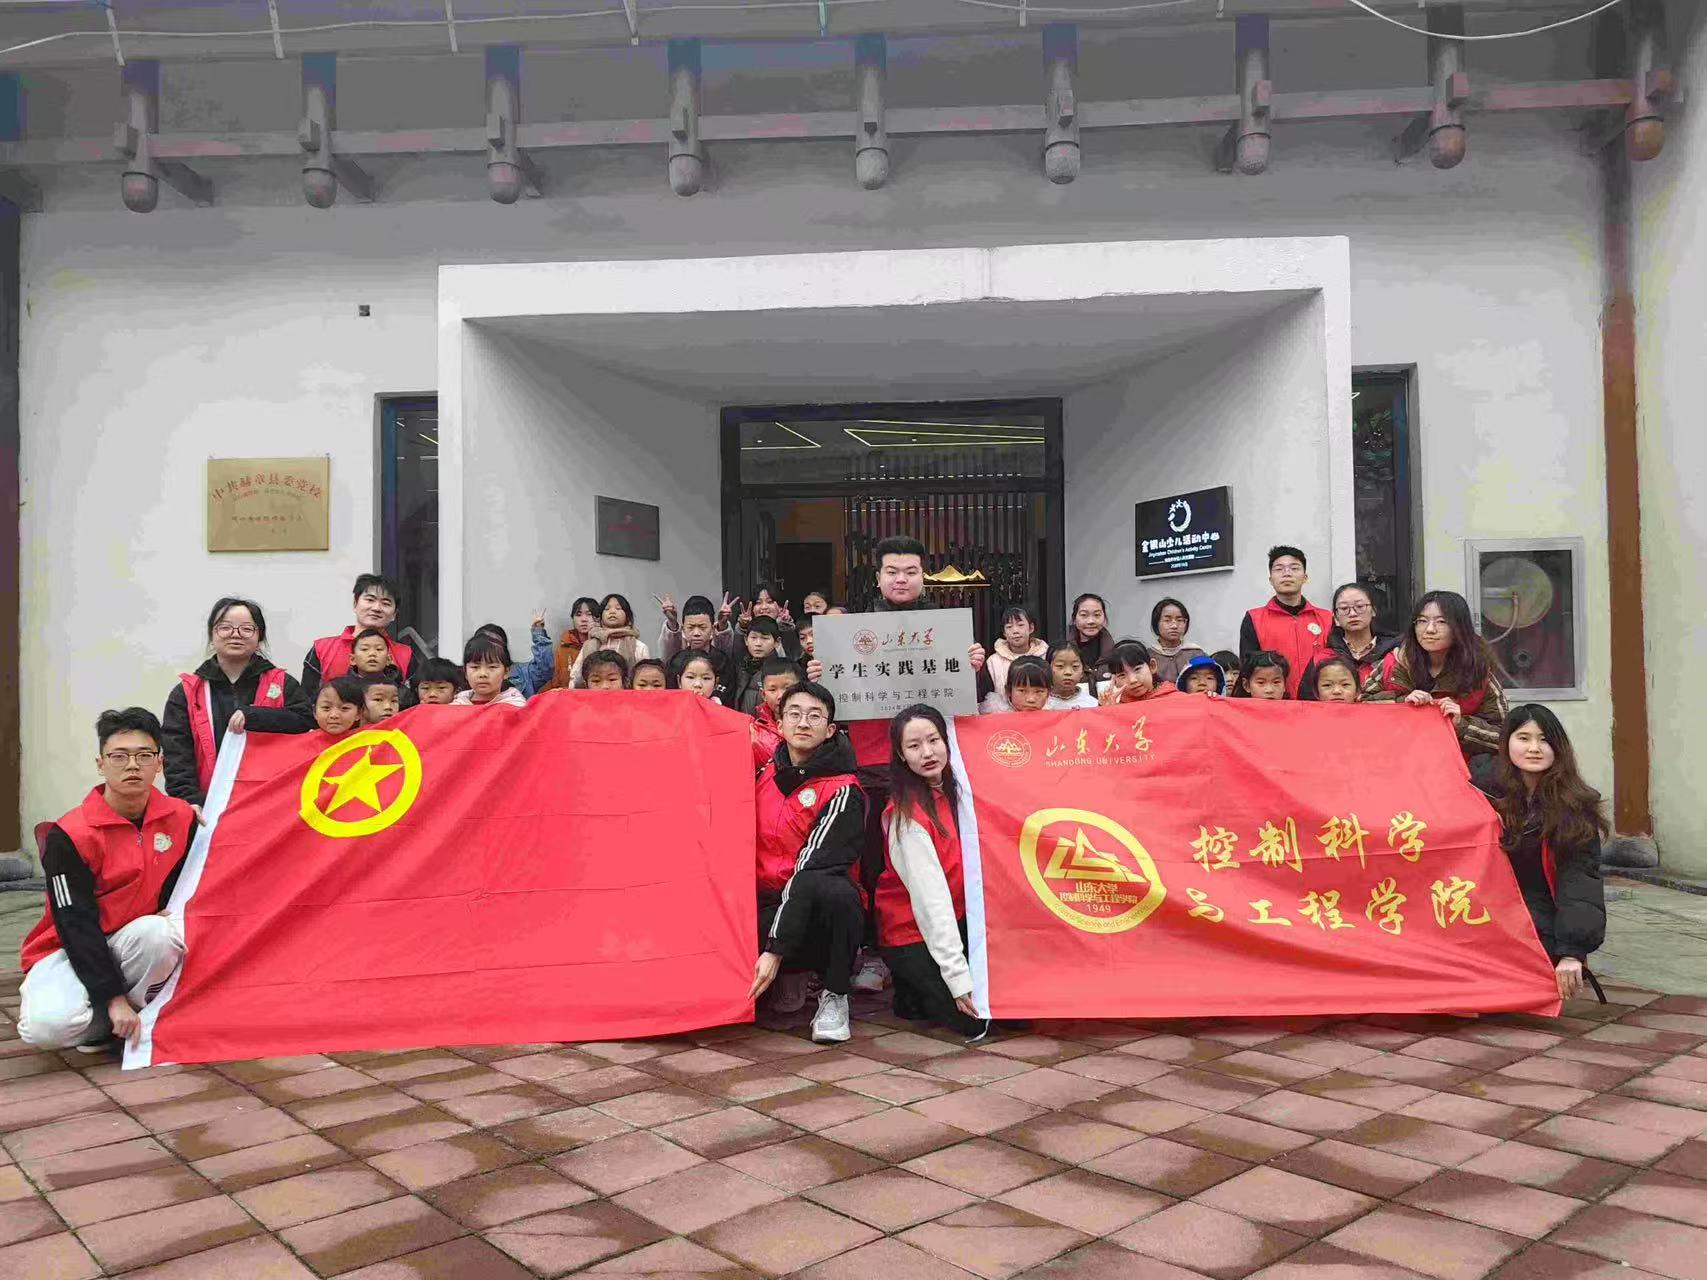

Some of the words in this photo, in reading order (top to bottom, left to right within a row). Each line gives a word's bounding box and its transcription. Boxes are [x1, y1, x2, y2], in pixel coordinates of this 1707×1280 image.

[829, 657, 961, 679] 学生实践基地
[838, 688, 954, 703] 控制科学与工程学院
[1046, 715, 1153, 757] 山东大学
[1045, 757, 1092, 768] SHANDONG
[1096, 754, 1155, 766] UNIVERSITY
[1189, 810, 1428, 873] 控制科学
[1076, 881, 1118, 894] 山东大学
[1087, 904, 1111, 913] 1949
[1185, 876, 1492, 935] 与工程学院
